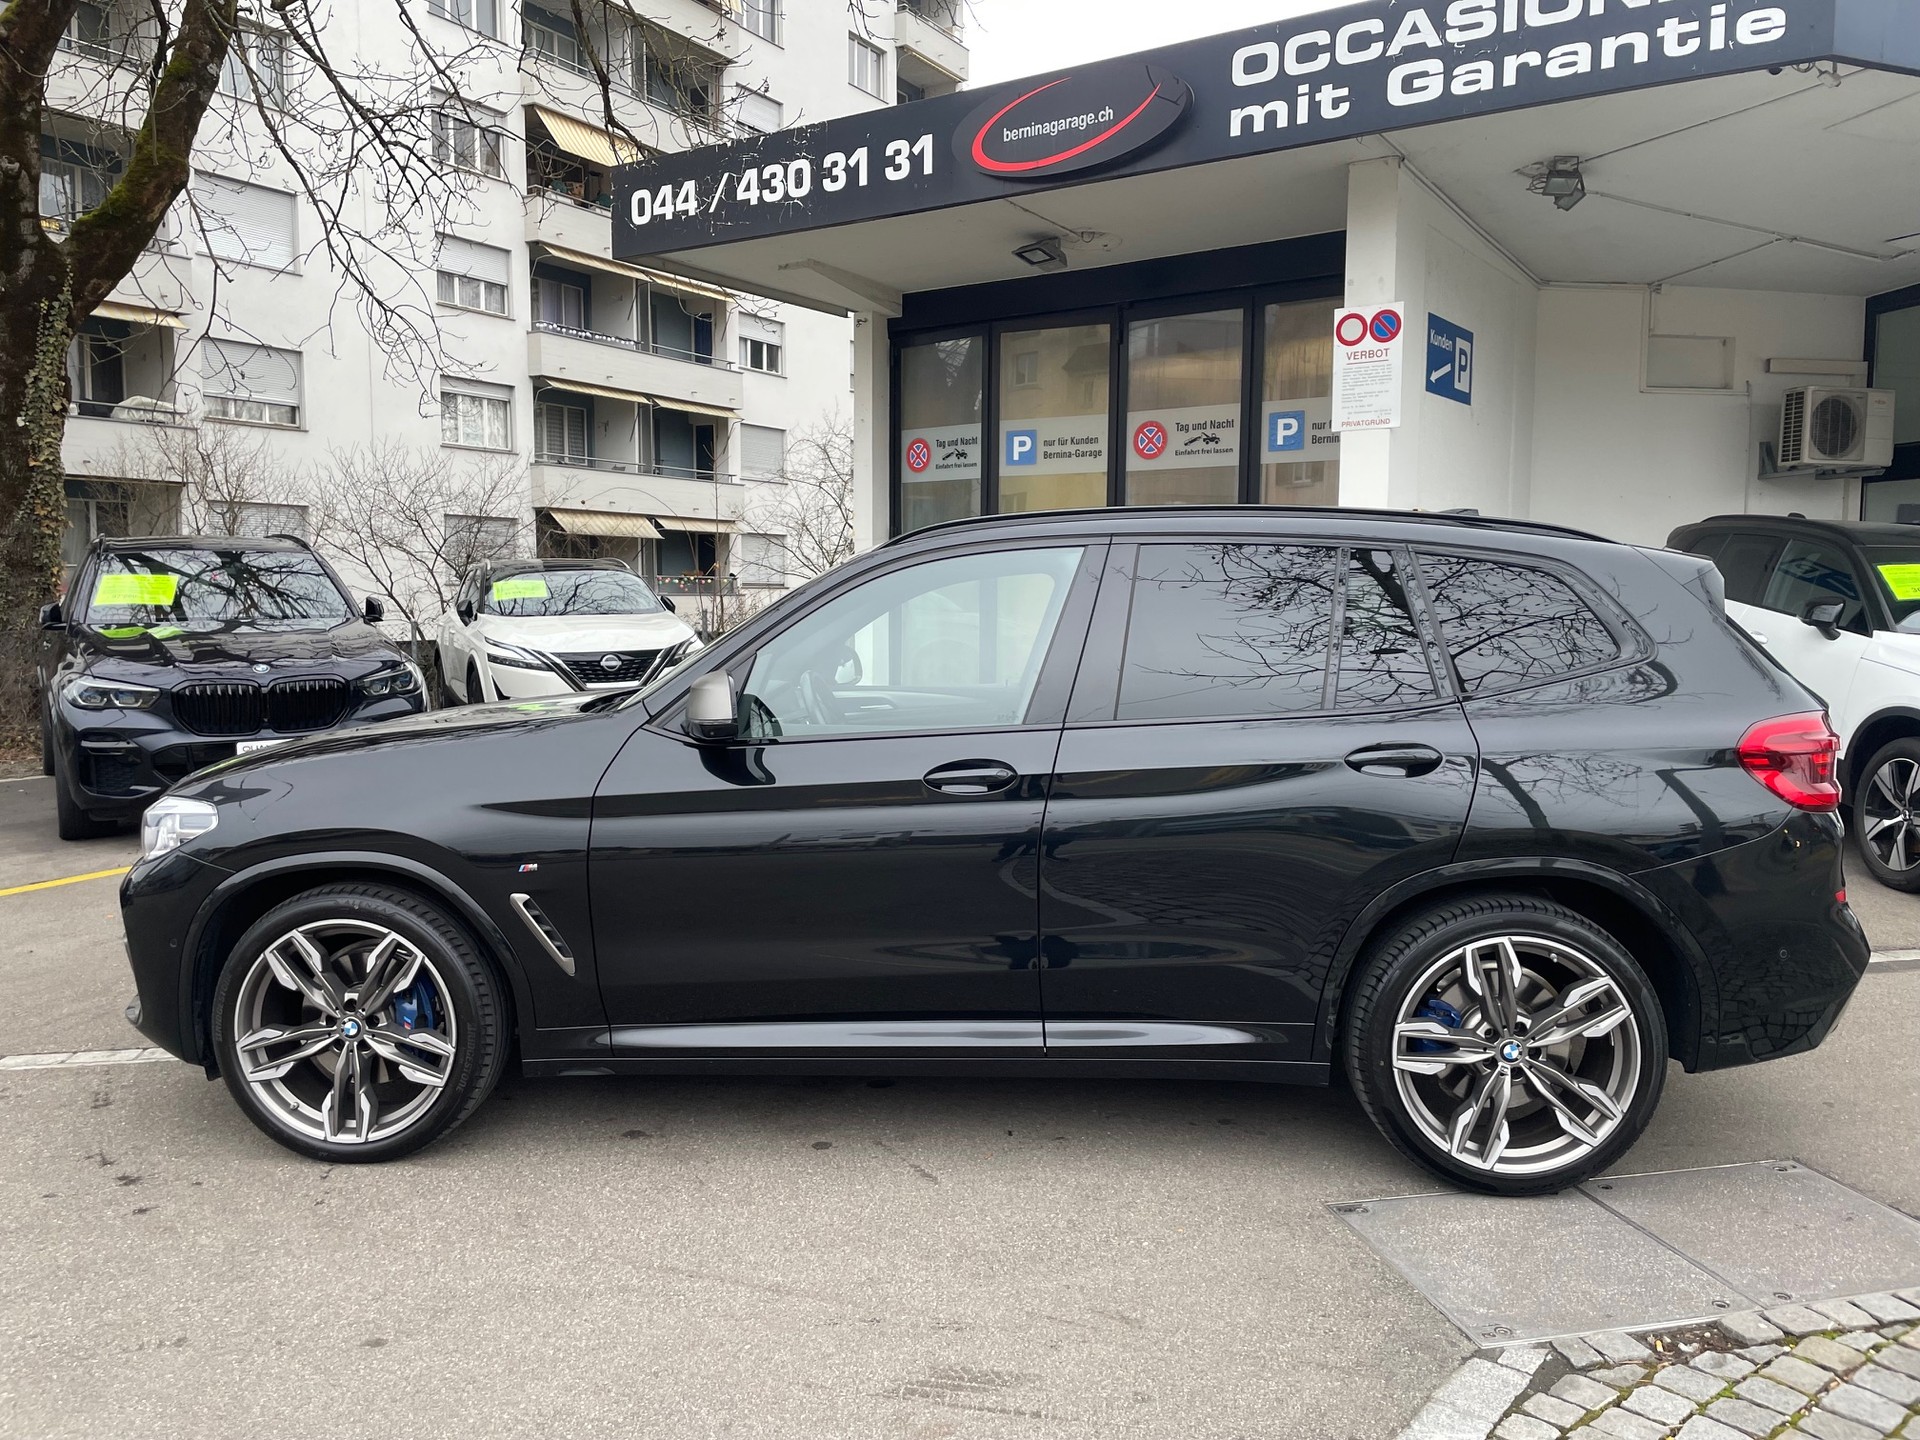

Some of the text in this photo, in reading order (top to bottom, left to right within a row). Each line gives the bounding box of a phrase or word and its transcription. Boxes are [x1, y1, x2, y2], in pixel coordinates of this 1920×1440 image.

[1229, 4, 1787, 137] mit Garantie
[1003, 105, 1114, 142] berninagarage.ch
[630, 180, 698, 226] 044
[736, 158, 812, 206] 430
[822, 146, 868, 192] 31
[885, 133, 933, 181] 31
[1430, 328, 1453, 352] Kunden
[1346, 348, 1390, 361] VERBOT
[1458, 347, 1468, 383] P
[1175, 419, 1235, 433] Tag und Nacht
[1311, 422, 1327, 430] nur
[1341, 418, 1391, 428] PRIVATGRUND
[1277, 418, 1299, 446] P
[936, 436, 978, 449] Tag und Nacht
[1043, 435, 1099, 447] nur für Kunden
[1311, 434, 1341, 445] Bernin
[1013, 435, 1032, 461] P
[1043, 449, 1103, 459] Bernina-Garage
[1175, 448, 1200, 456] Einfahrt
[1201, 447, 1212, 455] frei
